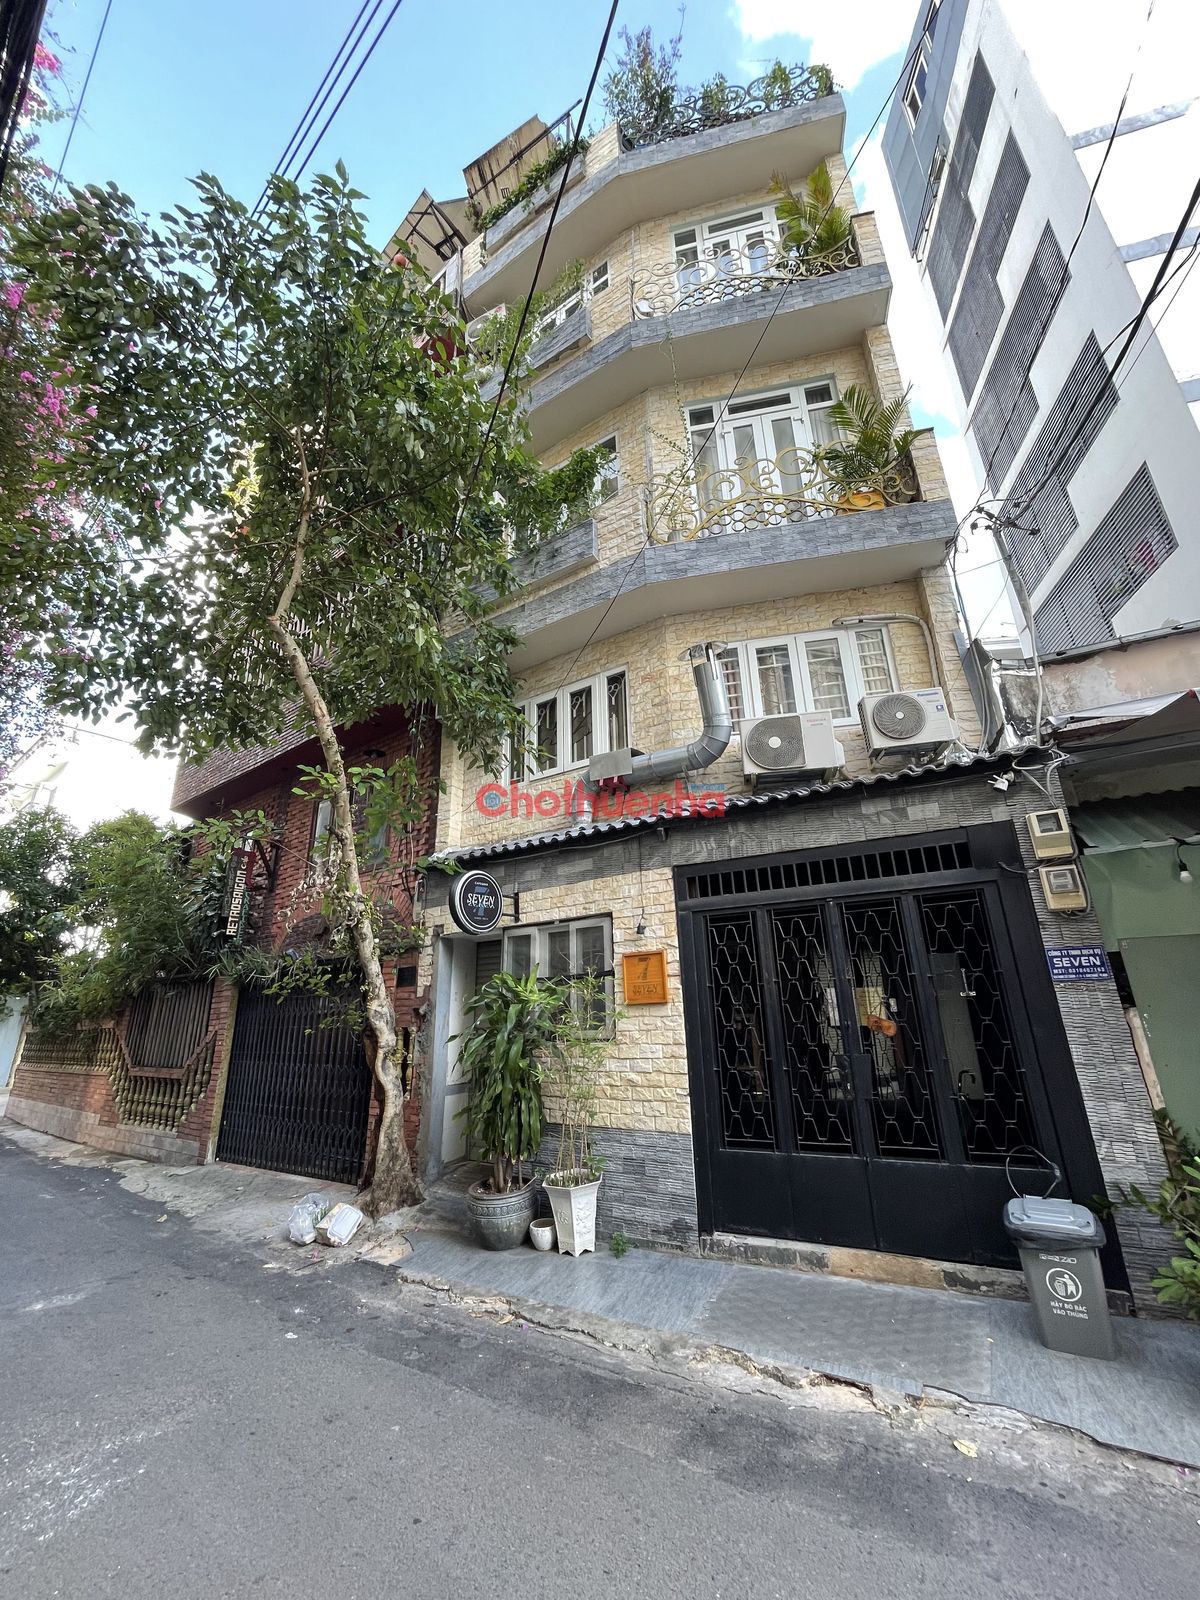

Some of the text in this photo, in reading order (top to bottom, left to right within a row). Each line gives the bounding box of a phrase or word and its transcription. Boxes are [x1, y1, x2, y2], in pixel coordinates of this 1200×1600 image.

[226, 870, 247, 936] RETROSAIGON
[467, 893, 496, 909] SEVEN
[1053, 956, 1101, 968] SEVEN
